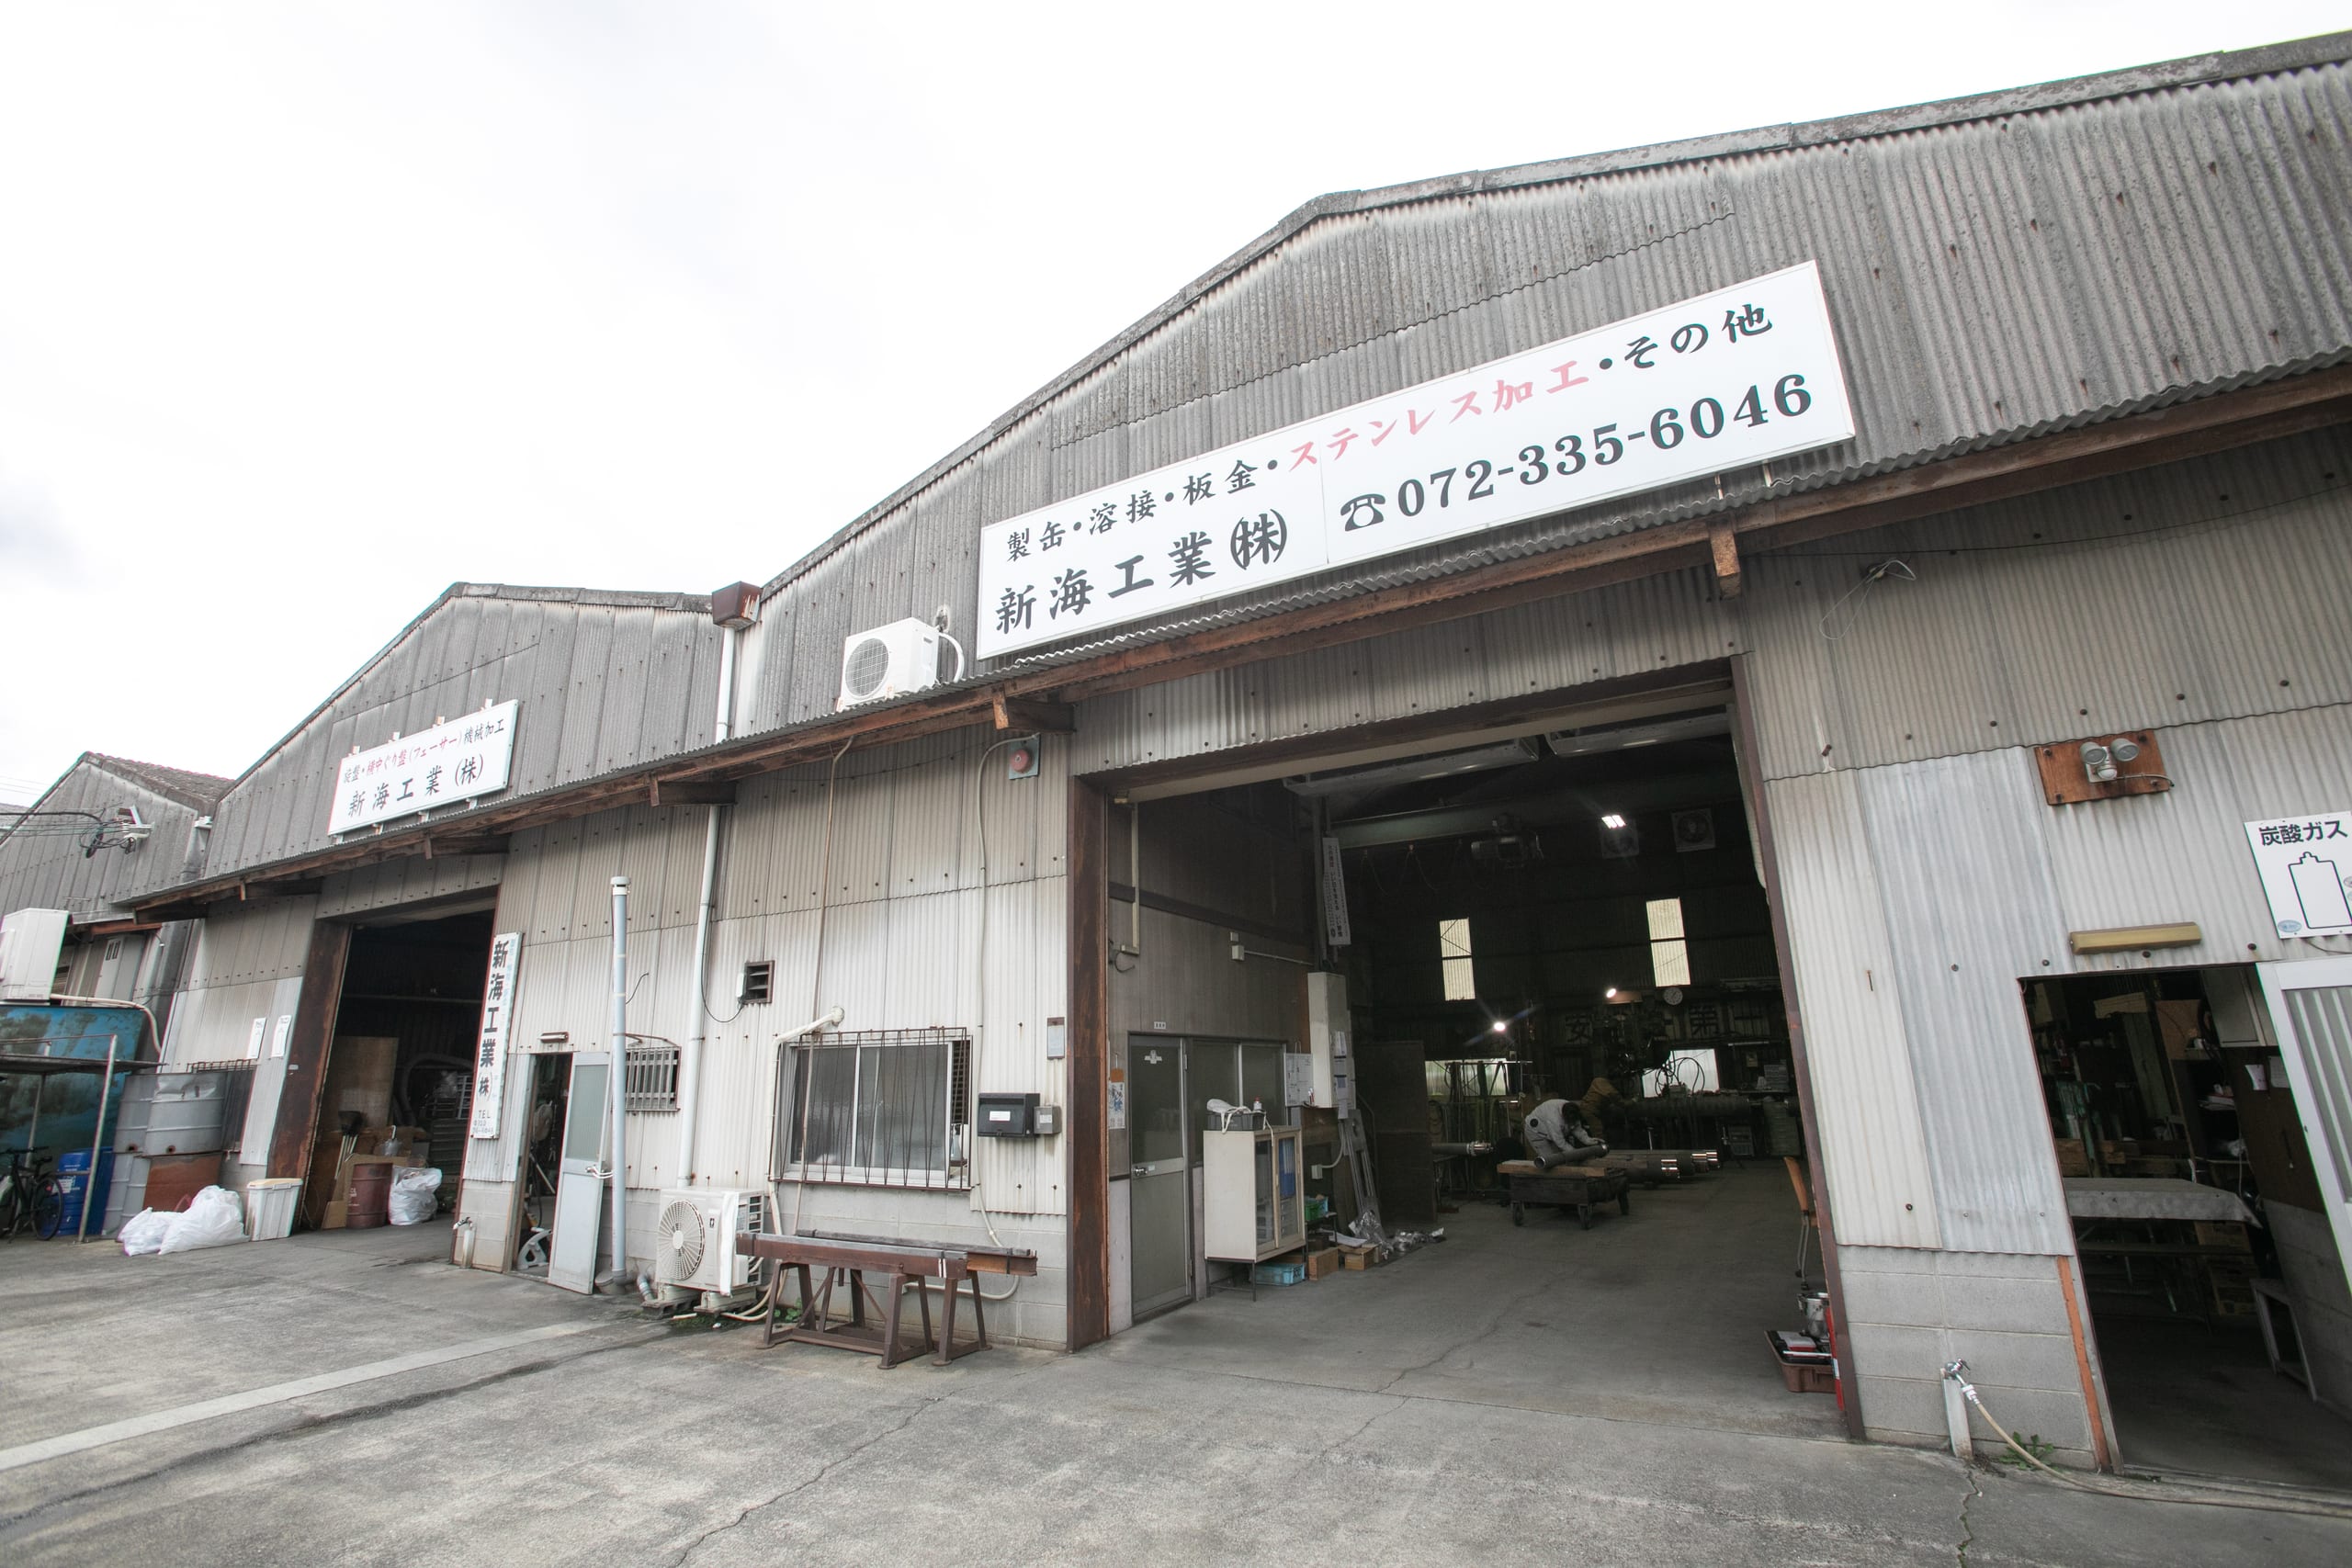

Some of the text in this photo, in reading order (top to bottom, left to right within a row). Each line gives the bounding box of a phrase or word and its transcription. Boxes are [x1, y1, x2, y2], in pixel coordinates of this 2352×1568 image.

[1396, 374, 1812, 519] 072-335-6046
[2258, 820, 2348, 846] 炭酸ガス
[478, 1109, 491, 1118] TEL
